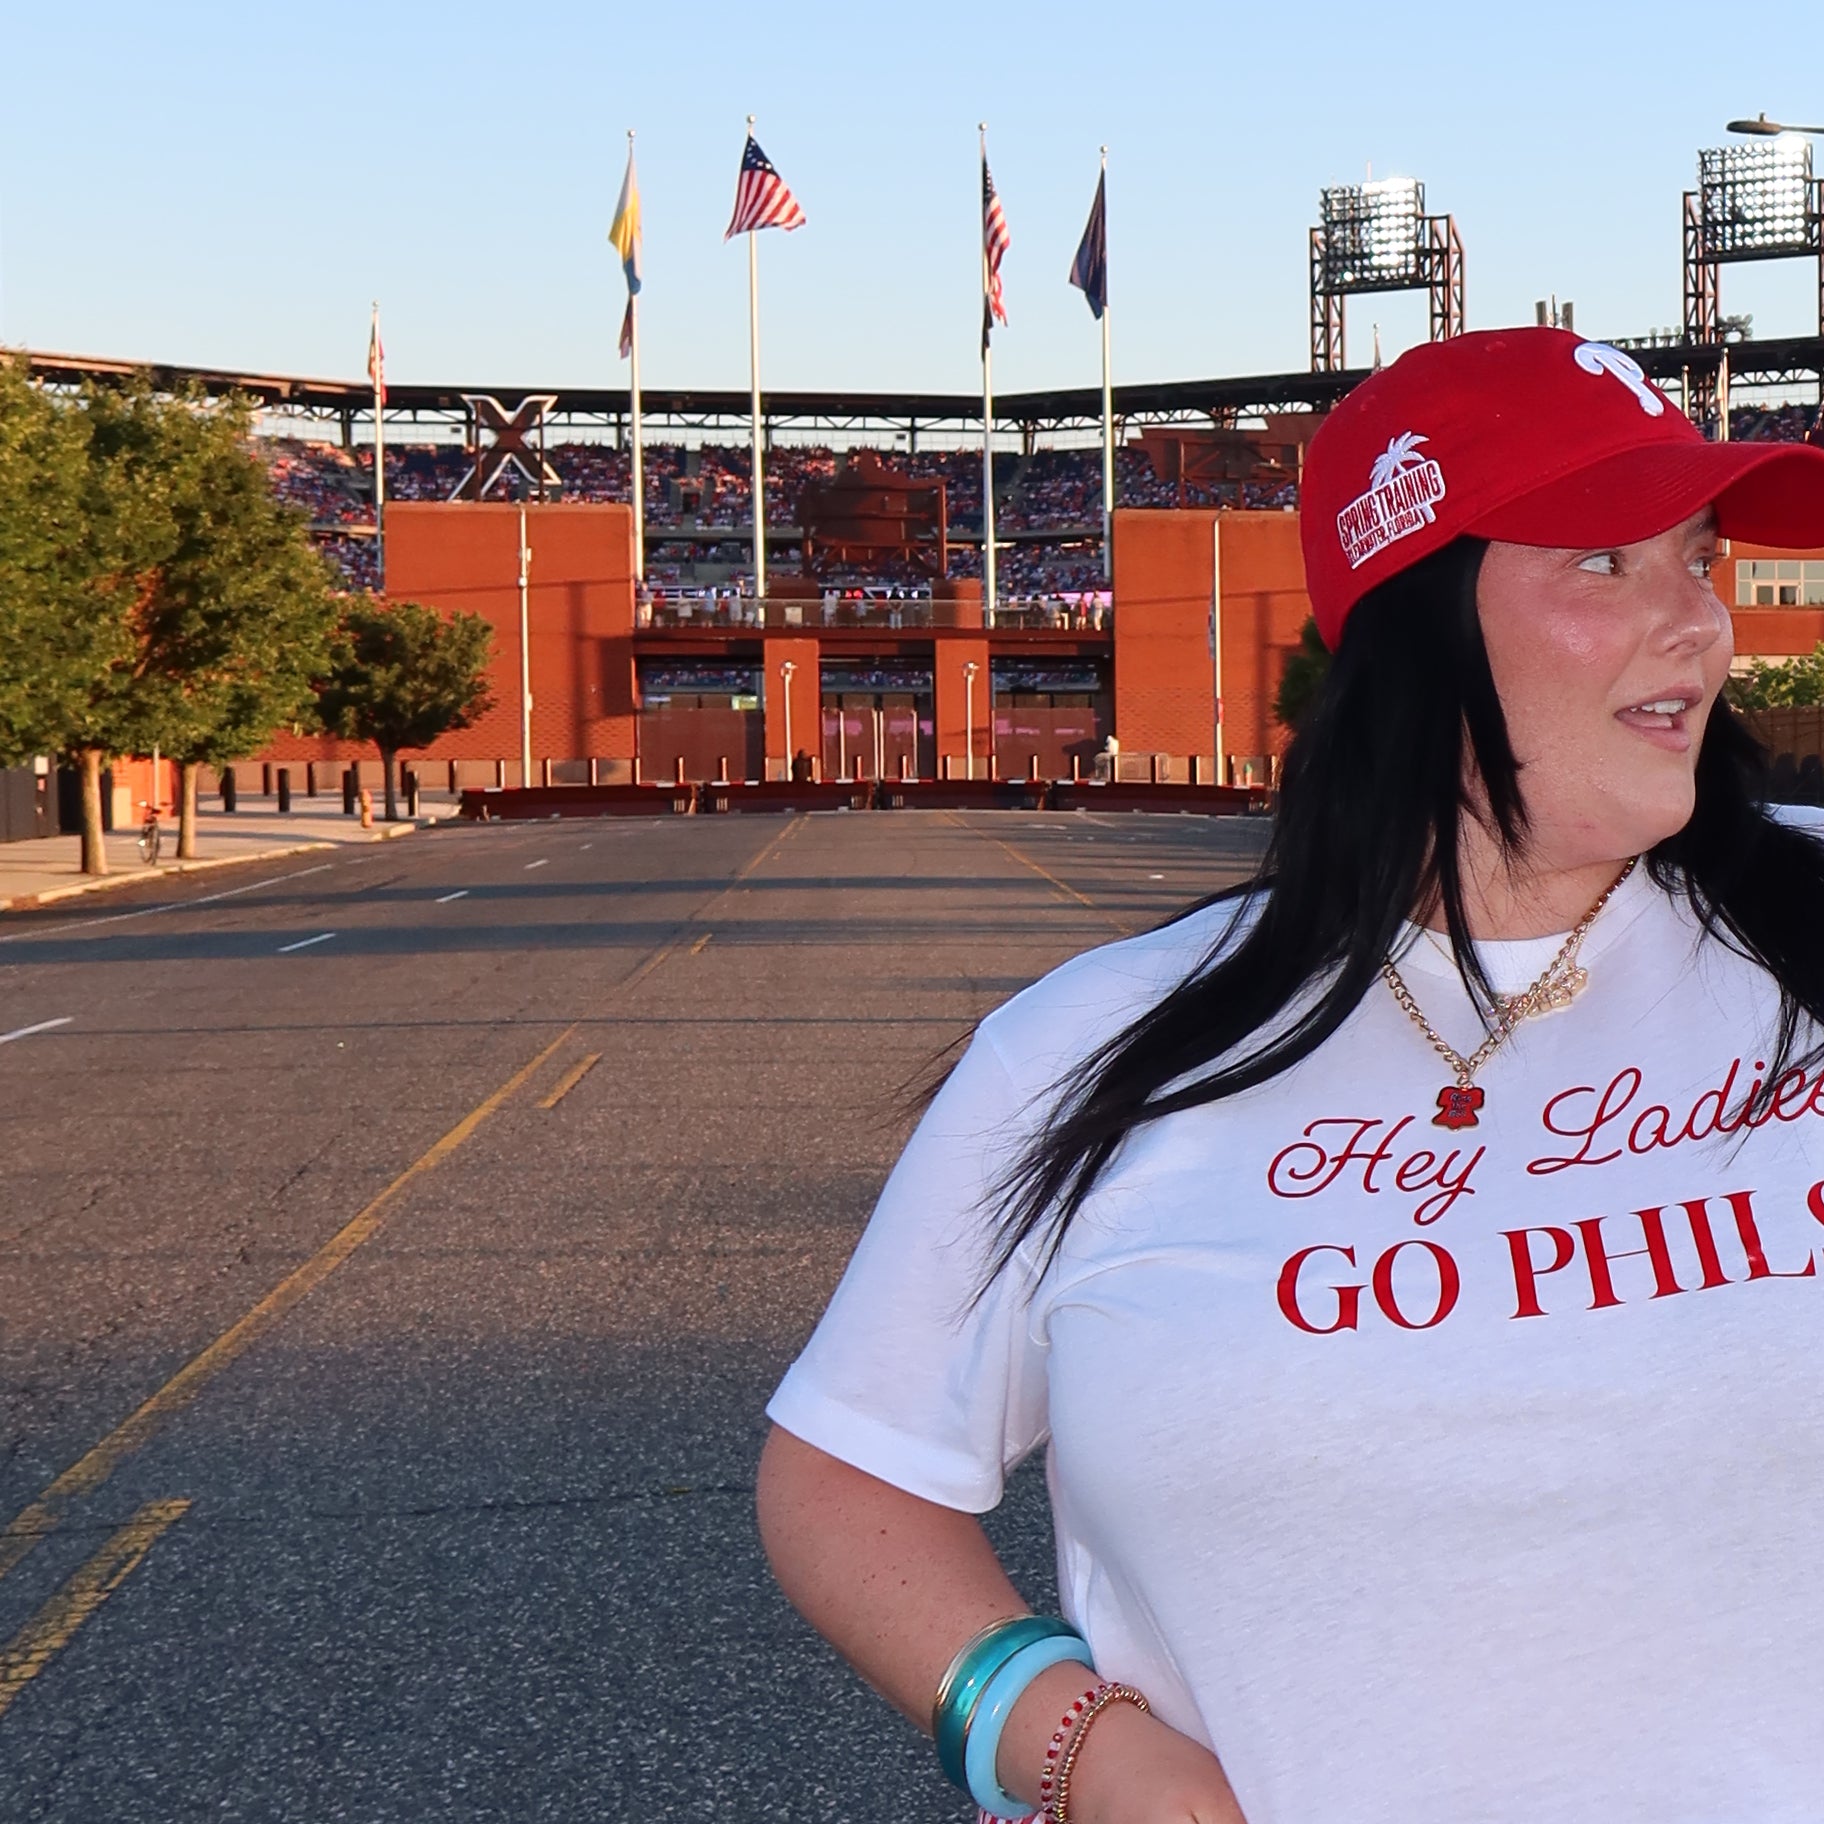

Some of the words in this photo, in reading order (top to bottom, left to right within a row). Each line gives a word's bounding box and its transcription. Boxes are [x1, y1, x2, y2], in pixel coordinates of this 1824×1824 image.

[1574, 342, 1664, 416] P
[447, 394, 562, 501] X
[1339, 495, 1380, 548] SPRING
[1375, 463, 1441, 521] TRAINING
[1266, 1114, 1487, 1226] Hey
[1276, 1239, 1461, 1335] GO
